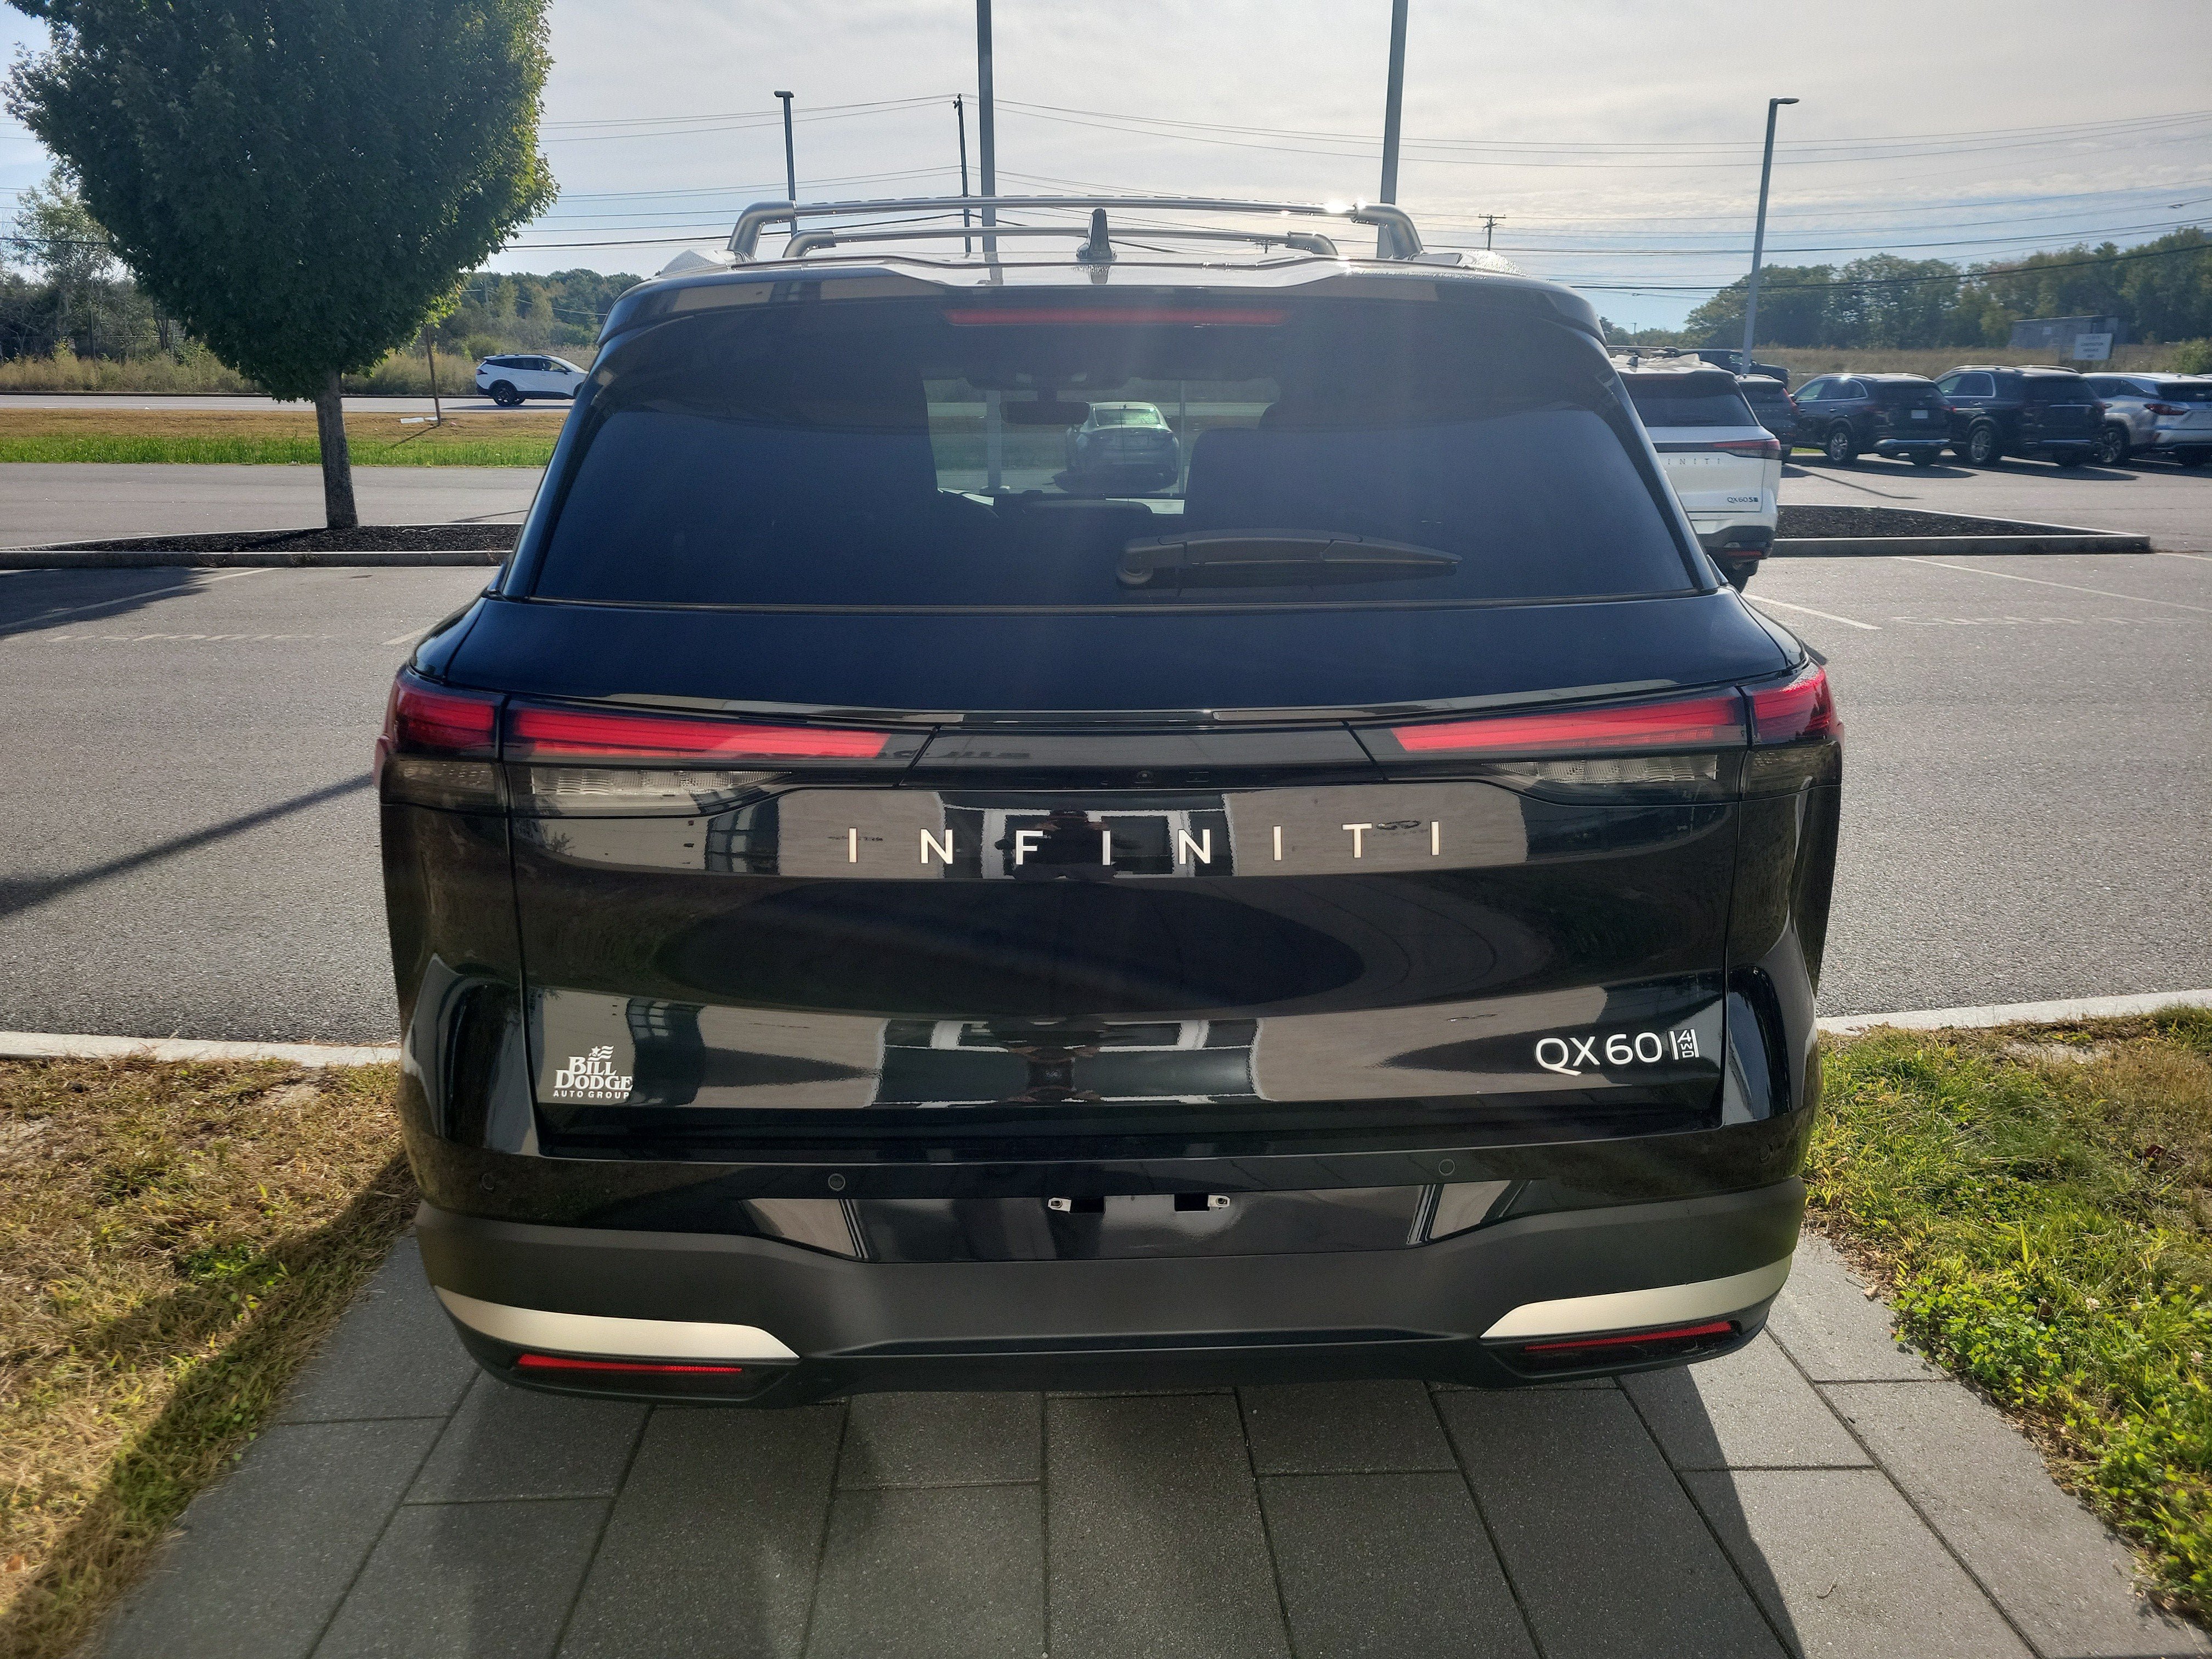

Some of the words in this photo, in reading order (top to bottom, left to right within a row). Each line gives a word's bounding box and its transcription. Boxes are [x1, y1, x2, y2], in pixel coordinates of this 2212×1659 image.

[848, 821, 1440, 866] INFINITI
[1536, 1032, 1662, 1076] QX60
[568, 1056, 617, 1075] BILL
[554, 1069, 633, 1091] DODGE
[588, 1091, 630, 1099] GROUP
